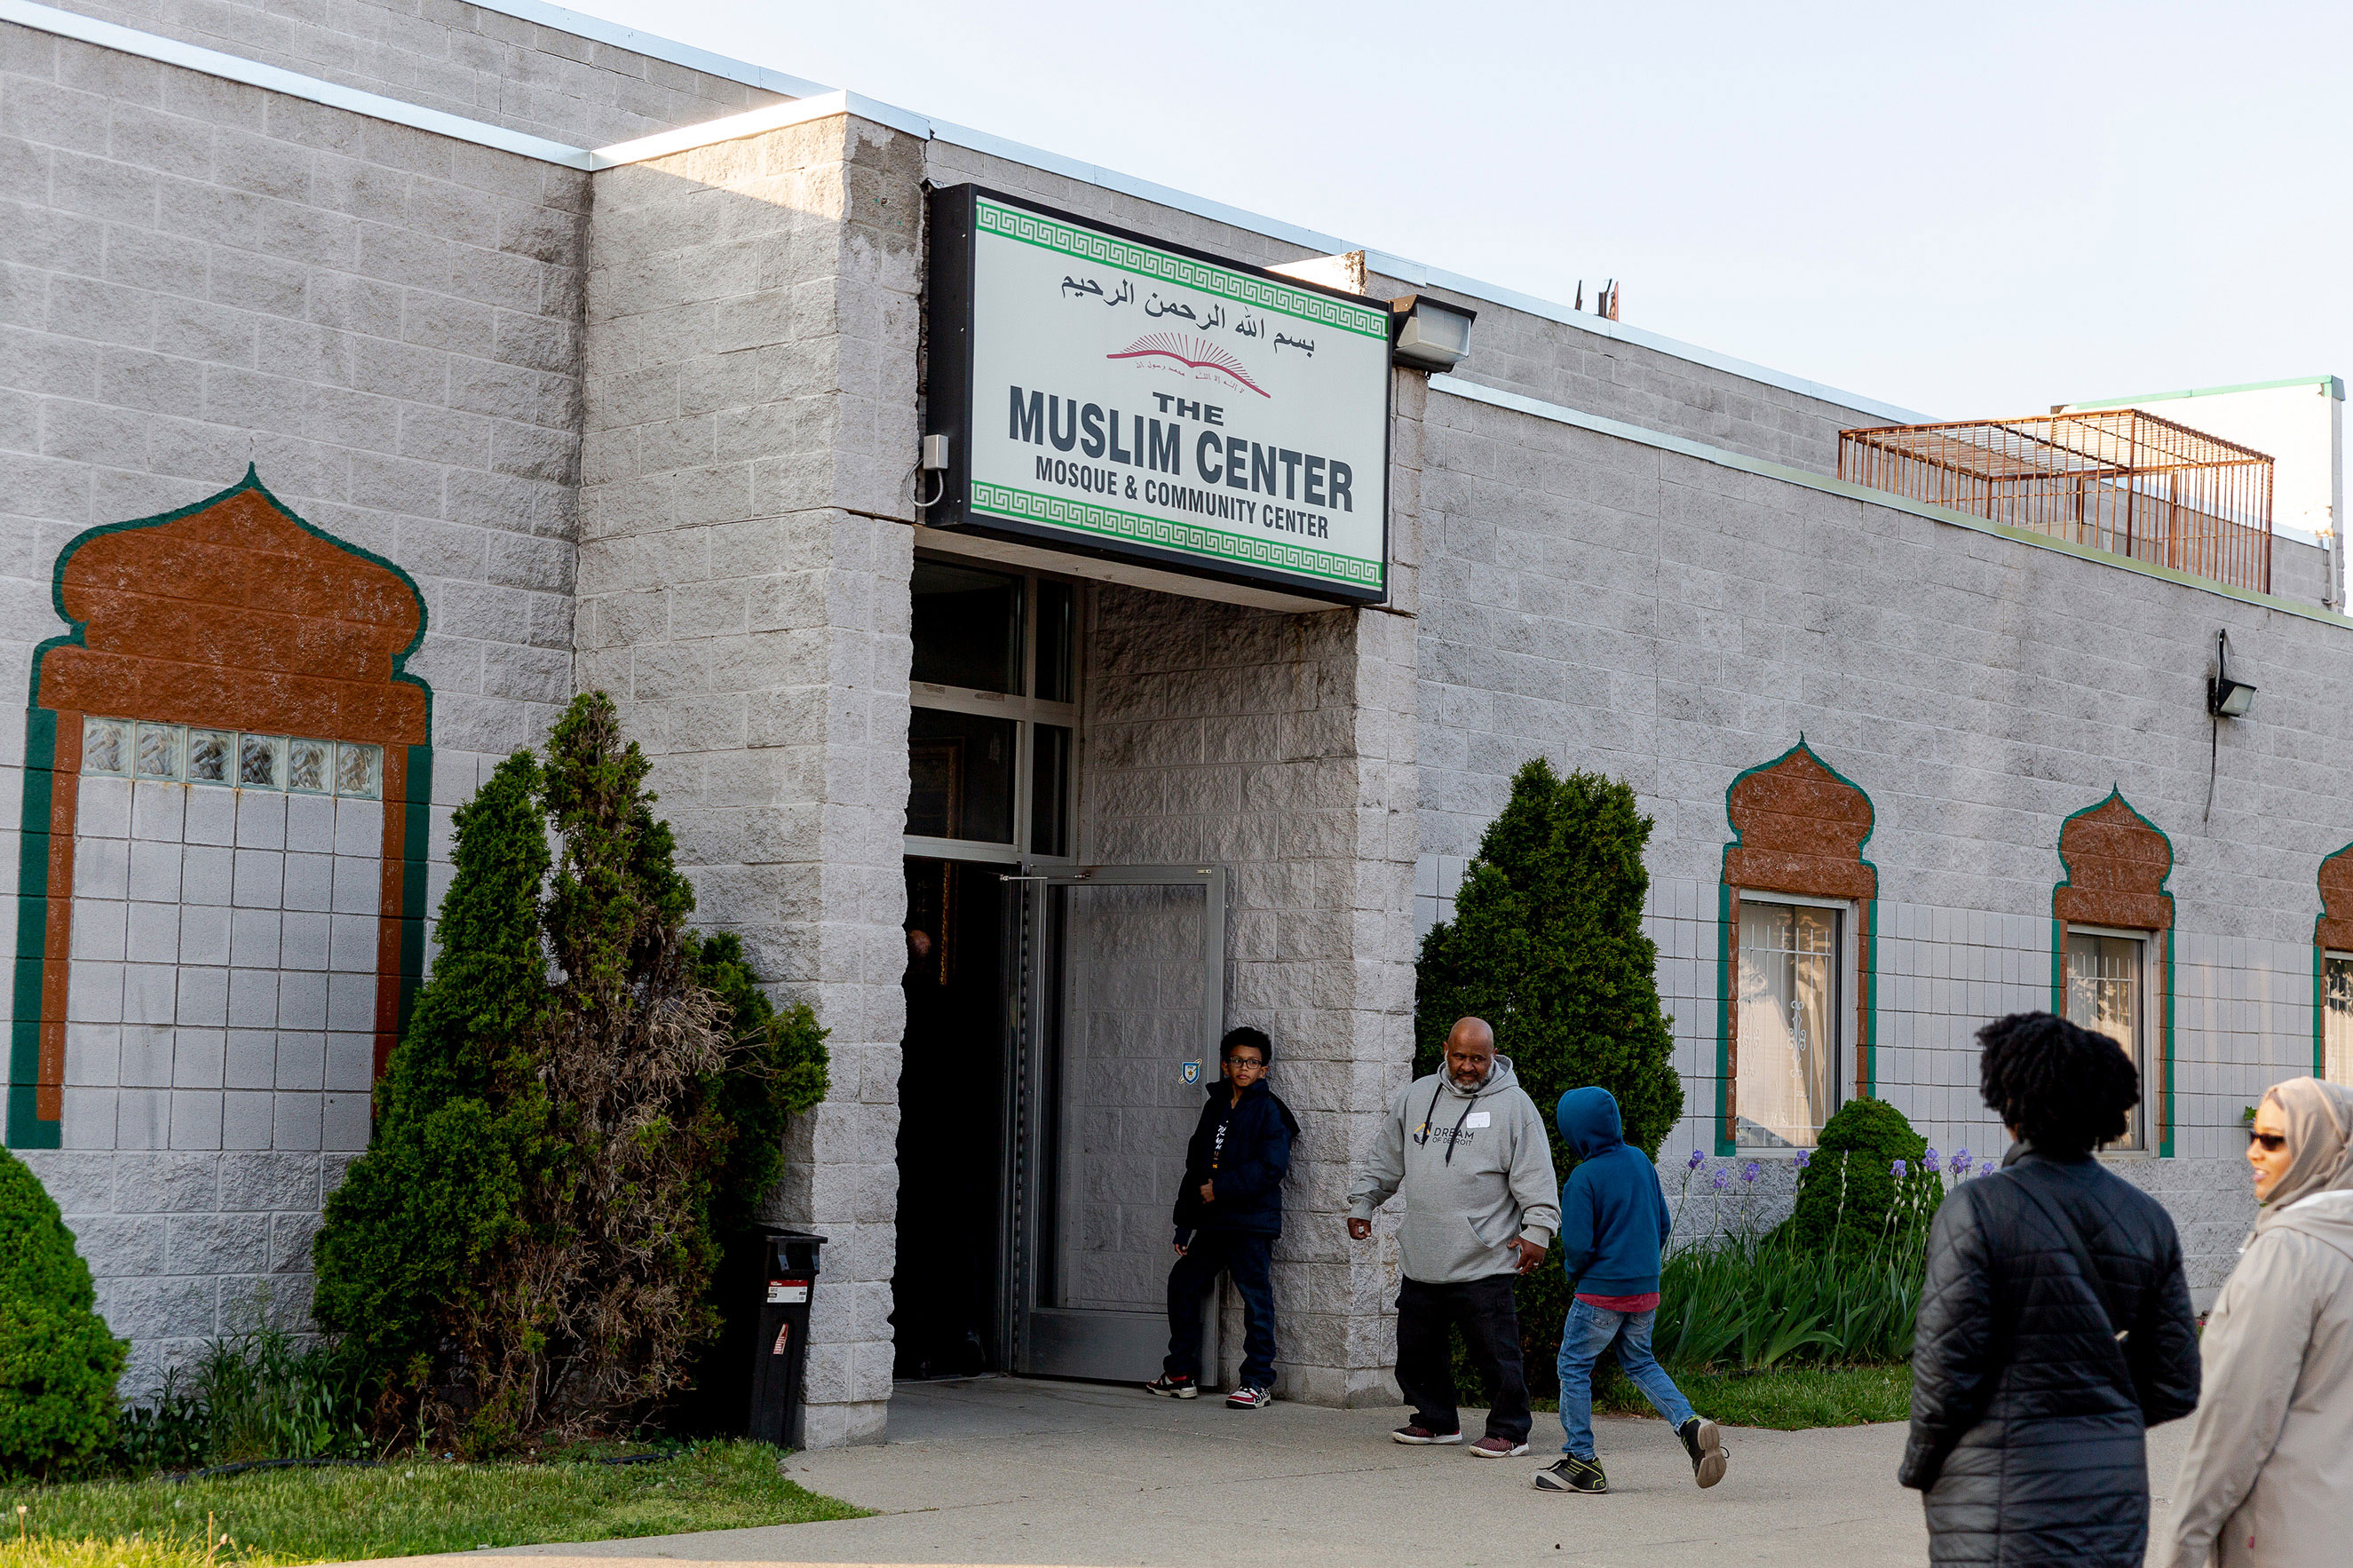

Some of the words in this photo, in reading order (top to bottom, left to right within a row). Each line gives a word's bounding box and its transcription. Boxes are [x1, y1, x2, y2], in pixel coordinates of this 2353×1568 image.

[1061, 275, 1135, 306] الرحيم
[1145, 292, 1225, 331] الرحمن
[1273, 330, 1315, 358] بسم
[1153, 392, 1224, 427] THE
[1009, 385, 1181, 476] MUSLIM
[1196, 431, 1353, 513] CENTER
[1035, 455, 1118, 497] MOSQUE
[1124, 475, 1138, 500] &
[1145, 479, 1257, 524] COMMUNITY
[1262, 504, 1329, 540] CENTER
